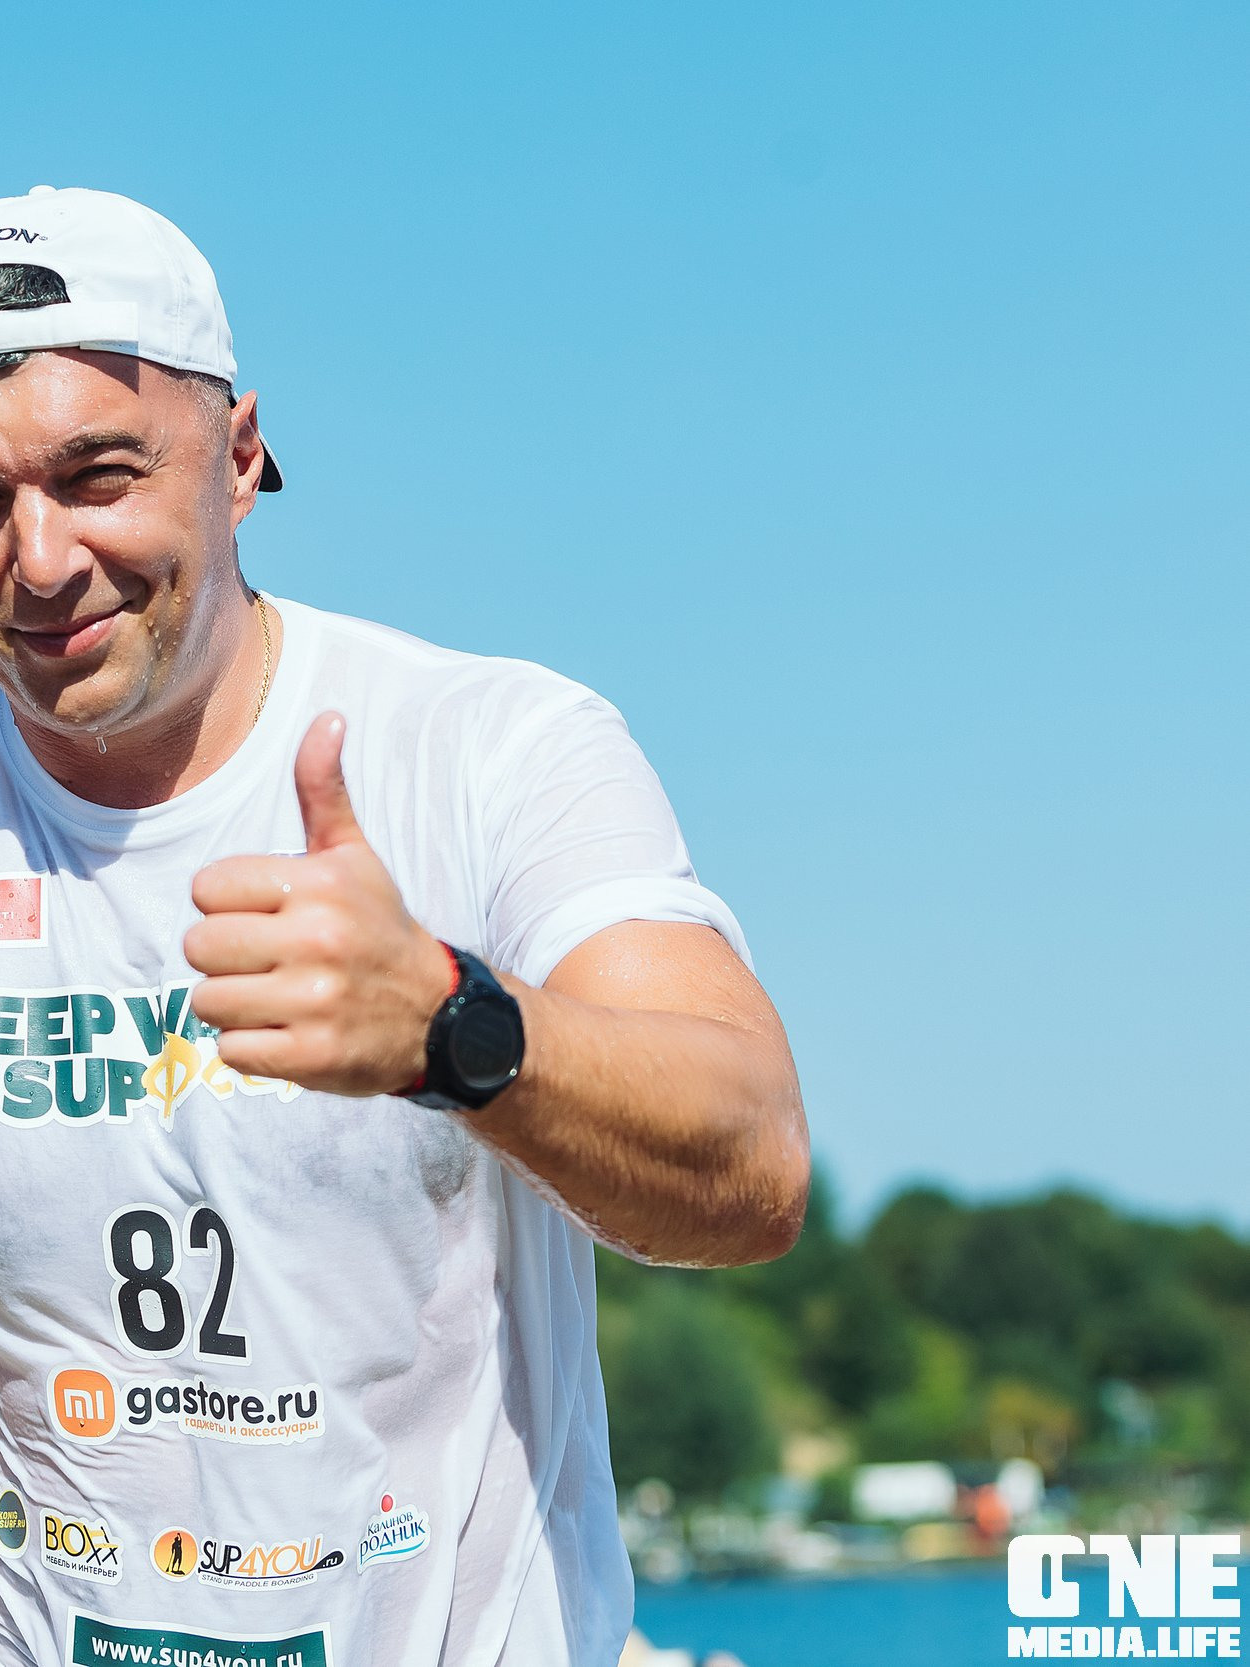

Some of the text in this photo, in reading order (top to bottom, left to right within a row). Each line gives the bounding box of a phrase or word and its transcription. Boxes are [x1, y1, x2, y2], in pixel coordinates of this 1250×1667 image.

[110, 1207, 247, 1358] 82
[126, 1381, 318, 1425] gastore.ru
[185, 1416, 319, 1437] гаджеты и аксессуары
[46, 1554, 118, 1578] МЕБЕЛЬ И ИНТЕРЬЕР
[201, 1573, 223, 1584] STAND
[234, 1580, 269, 1588] PADDLE
[271, 1573, 315, 1587] BOARDING
[91, 1636, 303, 1667] www.sup4youru
